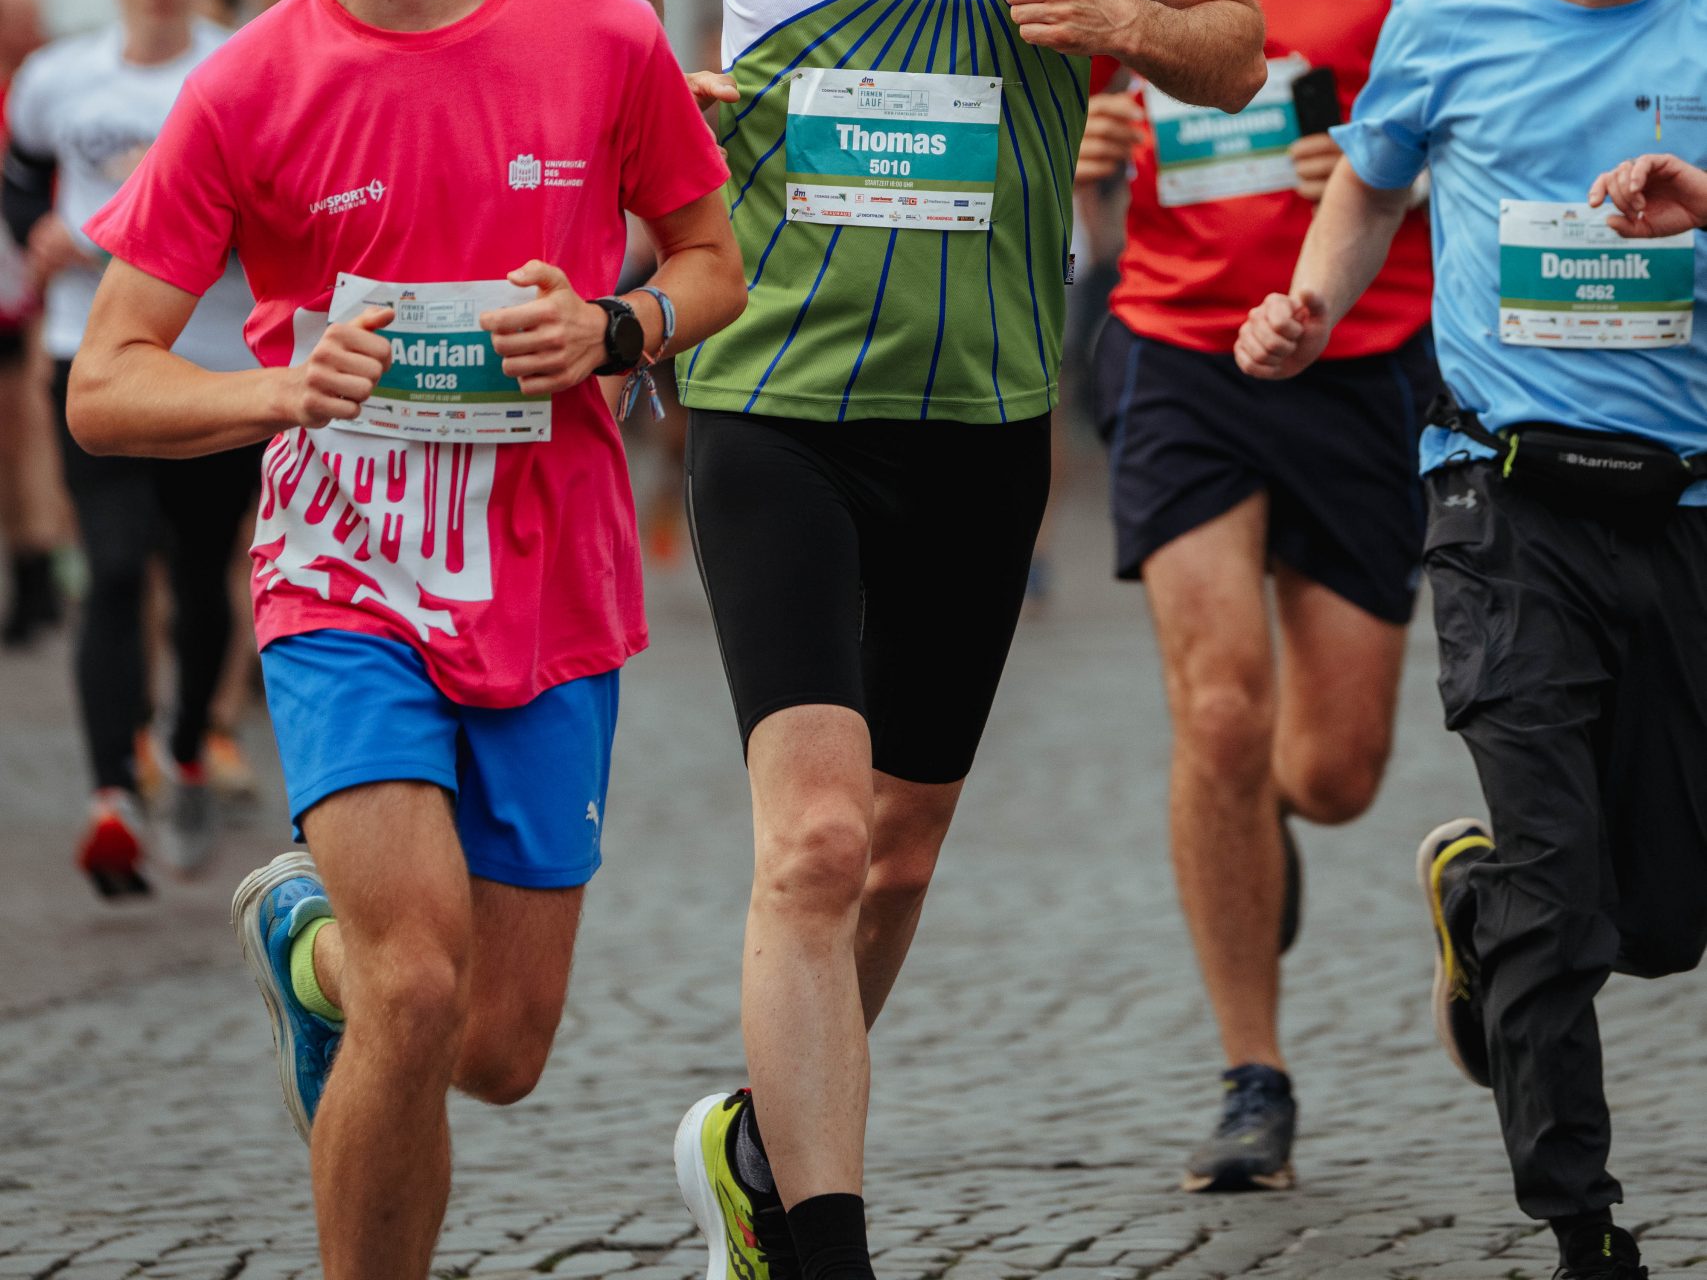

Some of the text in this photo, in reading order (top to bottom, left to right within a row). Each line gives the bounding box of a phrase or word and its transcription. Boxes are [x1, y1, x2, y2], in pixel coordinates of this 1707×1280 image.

[860, 98, 882, 107] LAUF
[836, 123, 947, 155] Thomas
[869, 159, 911, 176] 5010
[1540, 252, 1651, 279] Dominik
[1575, 284, 1615, 300] 4562
[391, 337, 485, 367] Adrian
[415, 372, 458, 389] 1028
[1579, 453, 1643, 470] karrimor
